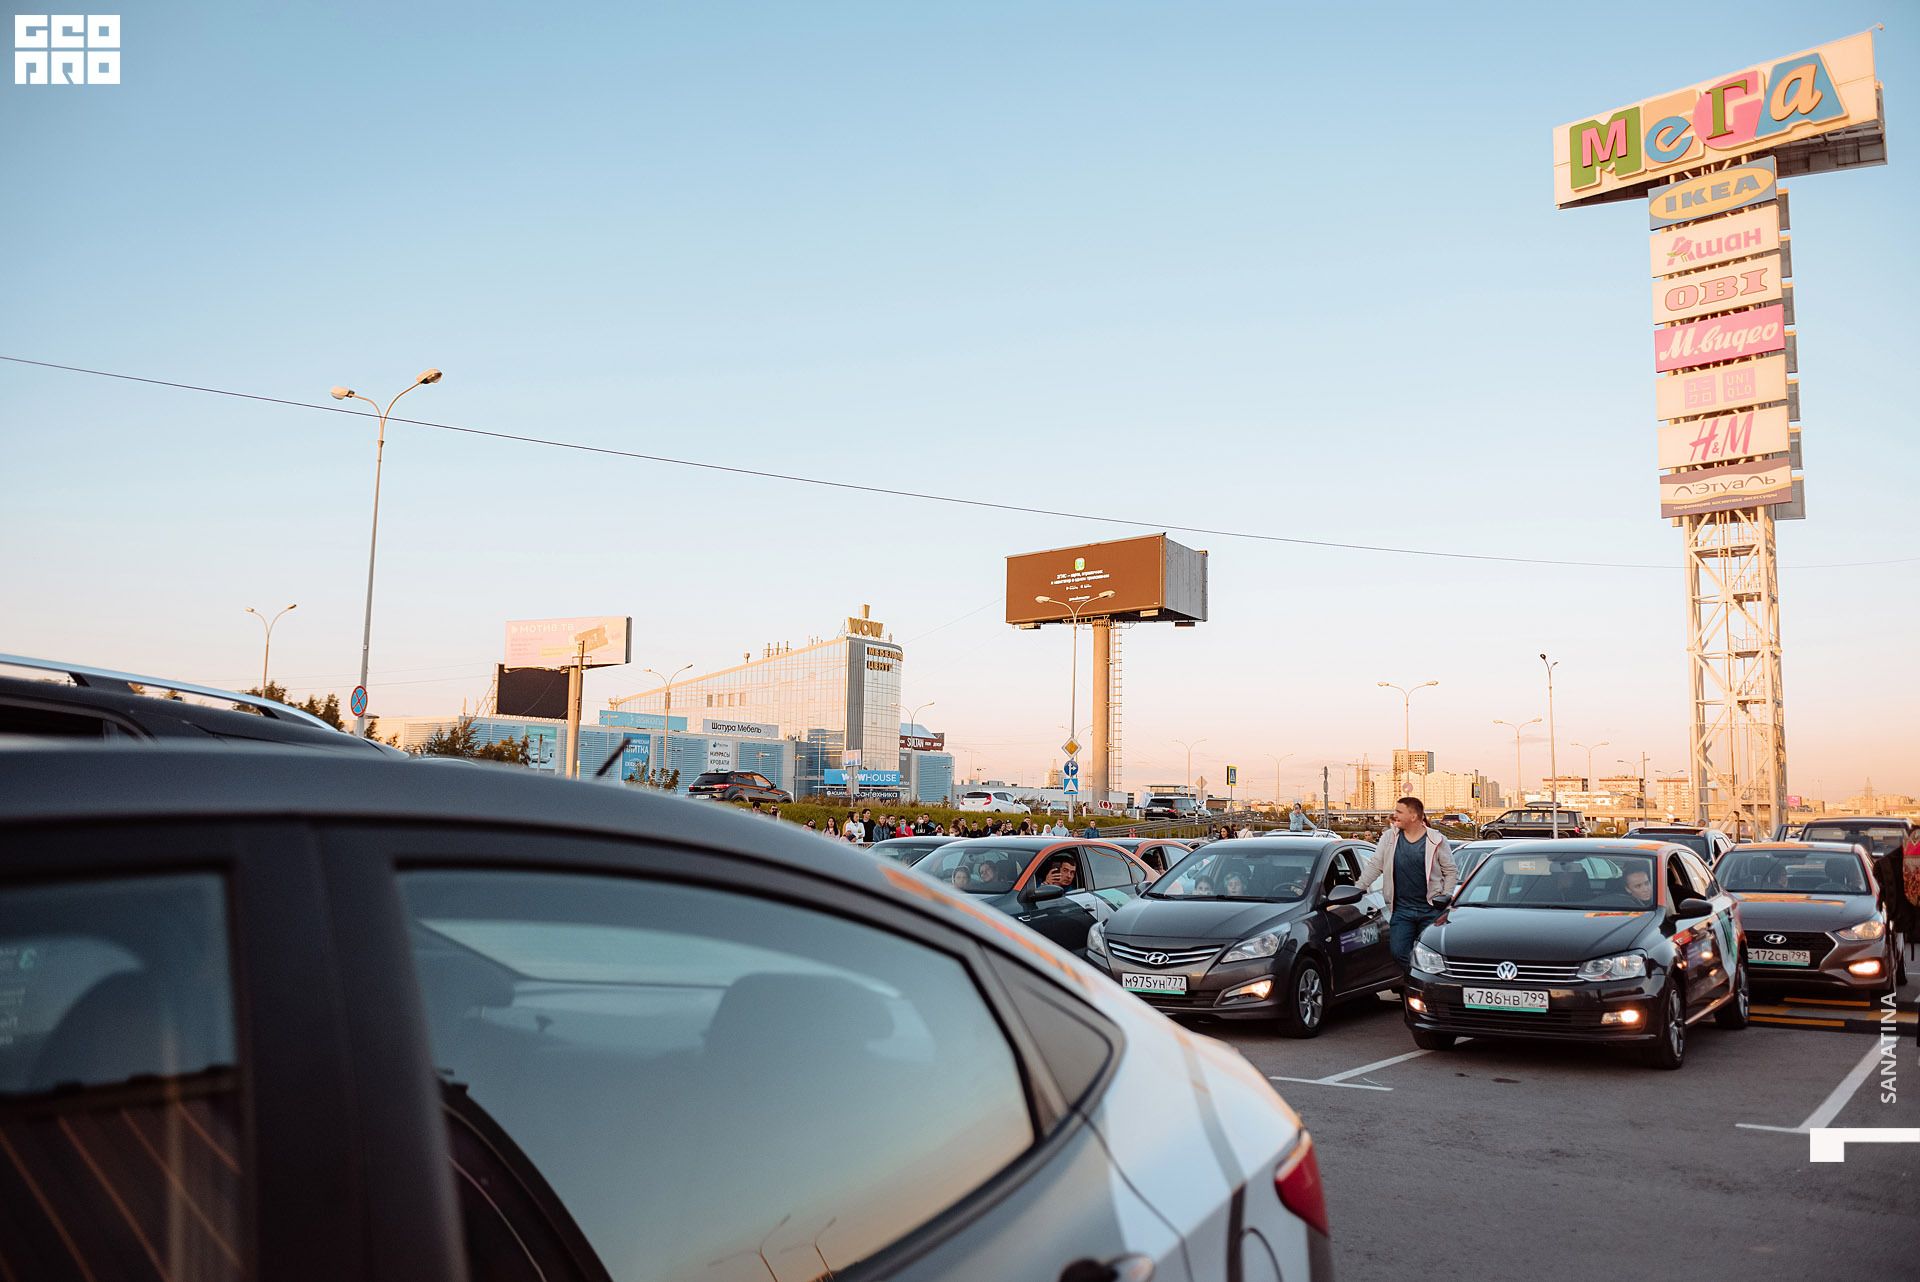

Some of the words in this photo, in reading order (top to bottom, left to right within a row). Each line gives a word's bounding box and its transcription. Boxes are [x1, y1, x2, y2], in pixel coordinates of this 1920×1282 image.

[1665, 174, 1761, 213] IKEA
[1666, 228, 1762, 266] Ашан
[1665, 268, 1768, 312] OBI
[1659, 322, 1778, 361] М.видео
[1726, 373, 1750, 386] UNI
[1727, 385, 1752, 399] QLO
[1689, 412, 1754, 462] H&M
[520, 623, 557, 633] МОТИВ
[561, 623, 575, 632] ТВ
[848, 616, 884, 639] WOW
[867, 660, 894, 672] ЦЕНТР
[636, 716, 665, 726] askona
[711, 722, 737, 732] Шатура
[737, 723, 762, 734] Мебель
[1791, 951, 1807, 960] 799
[1125, 975, 1166, 989] М975УН
[1167, 977, 1183, 987] 777
[1467, 990, 1521, 1006] К786НВ
[1523, 992, 1545, 1004] 799
